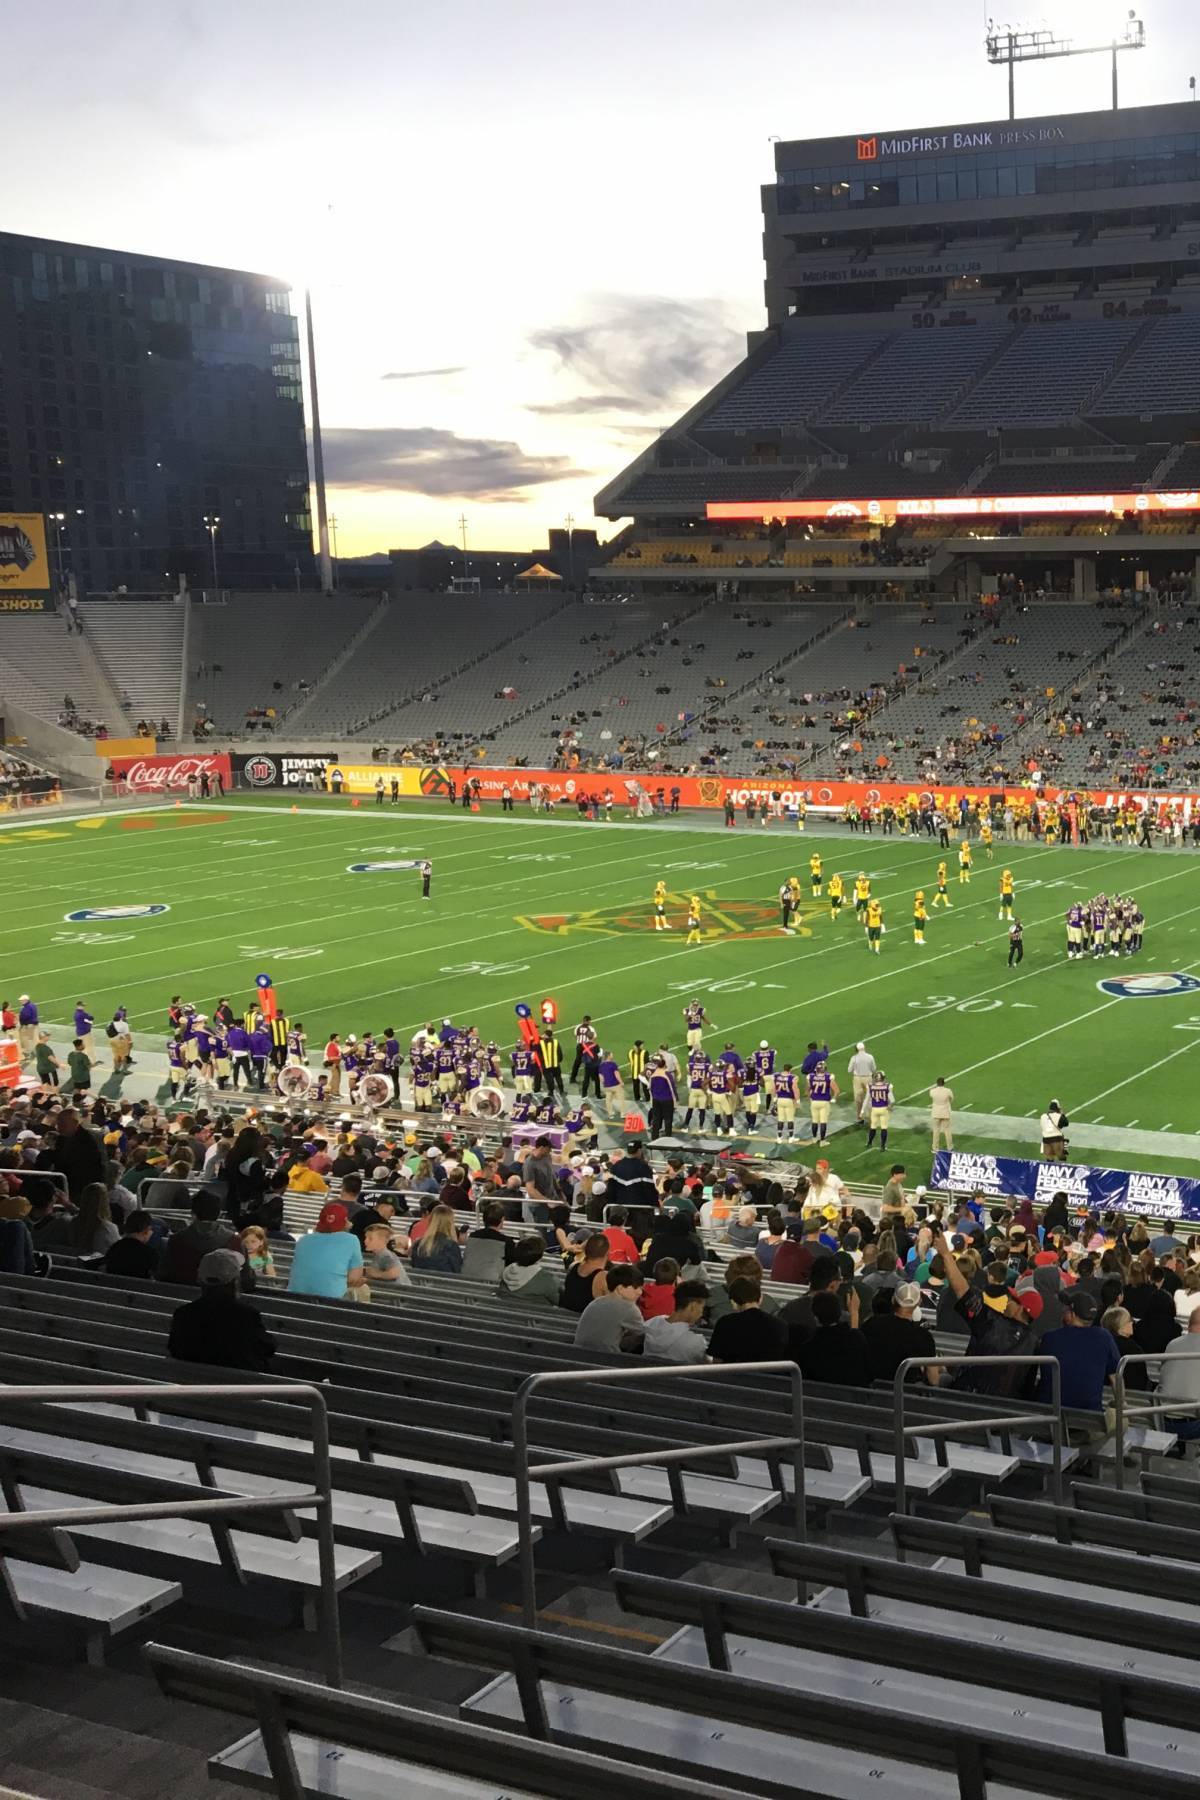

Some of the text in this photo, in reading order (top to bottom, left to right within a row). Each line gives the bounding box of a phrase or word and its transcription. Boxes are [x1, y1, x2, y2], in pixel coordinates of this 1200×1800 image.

[953, 132, 992, 149] BANK
[999, 129, 1036, 145] PRESS
[1039, 127, 1065, 141] BOX
[1007, 306, 1031, 324] 42
[742, 782, 793, 790] ARIZONA
[439, 961, 531, 976] 50
[667, 977, 761, 993] 40
[542, 1004, 553, 1018] 2
[907, 995, 1004, 1013] 30
[762, 1057, 769, 1069] 6
[711, 1076, 724, 1088] 24
[812, 1082, 827, 1095] 77
[871, 1088, 886, 1102] 44
[625, 1116, 639, 1129] 30
[951, 1153, 984, 1167] NAVY
[949, 1166, 1000, 1180] FEDERAL
[1038, 1164, 1073, 1178] NAVY
[948, 1180, 998, 1194] Credit Union
[1037, 1176, 1089, 1191] FEDERAL
[1129, 1174, 1165, 1188] NAVY
[1066, 1194, 1088, 1205] nion
[1127, 1186, 1181, 1202] FEDERAL
[1125, 1201, 1182, 1218] Credit Union
